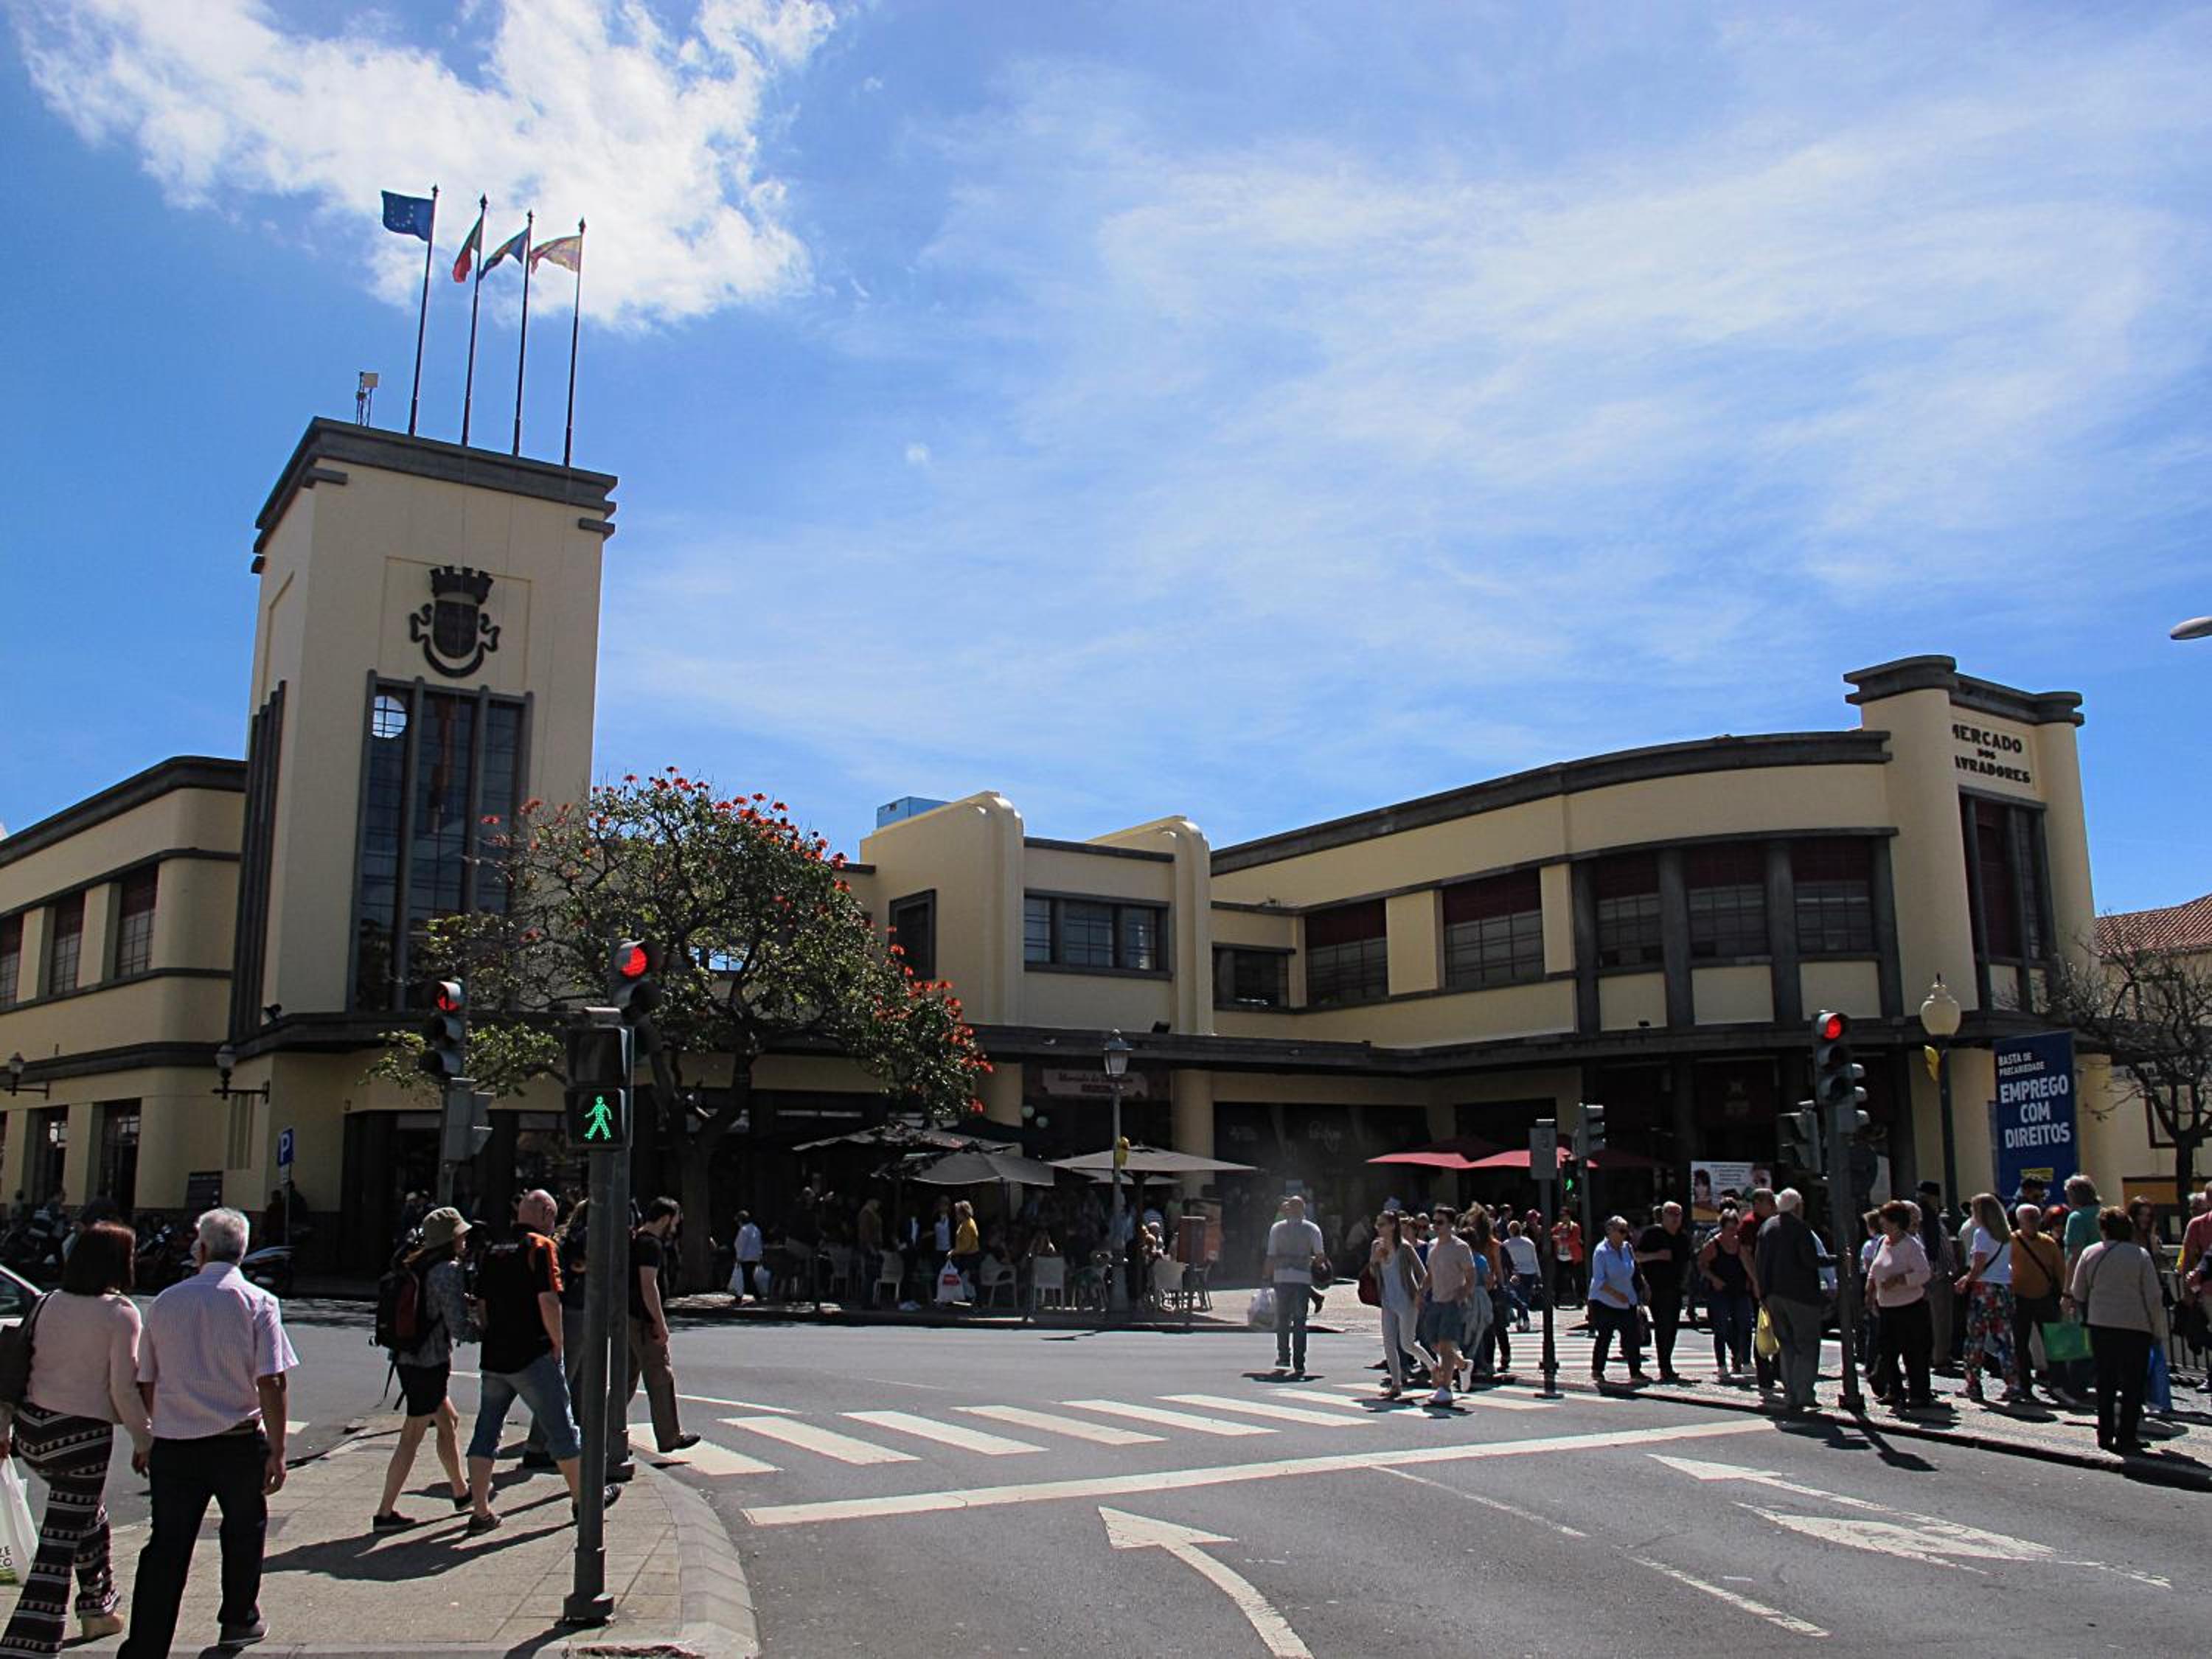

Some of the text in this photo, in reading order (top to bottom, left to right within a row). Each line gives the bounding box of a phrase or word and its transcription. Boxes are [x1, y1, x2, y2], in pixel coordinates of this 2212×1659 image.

[1955, 755, 2031, 784] VRADORES
[2000, 1074, 2068, 1104] EMPREGO
[2020, 1101, 2051, 1123] COM
[279, 1133, 291, 1164] P
[2006, 1121, 2070, 1149] DIREITOS
